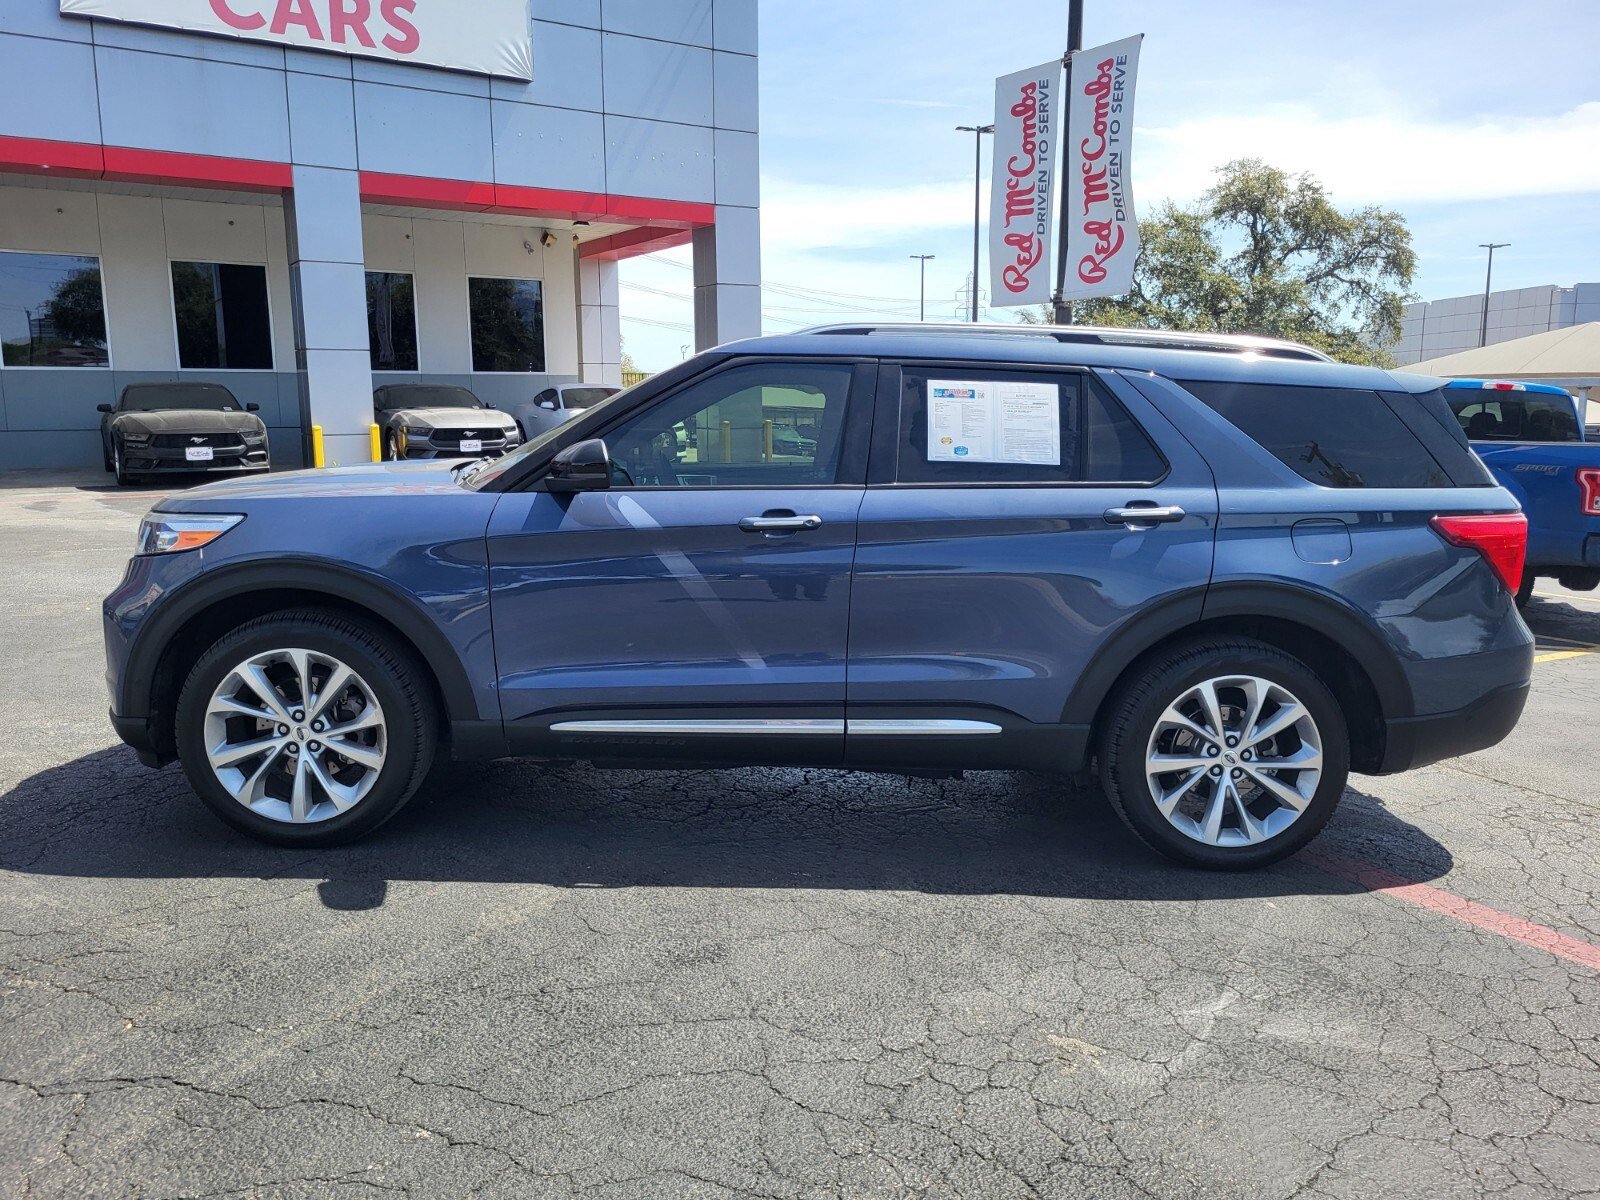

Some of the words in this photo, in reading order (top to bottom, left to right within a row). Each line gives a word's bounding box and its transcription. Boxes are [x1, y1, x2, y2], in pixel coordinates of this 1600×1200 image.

[1038, 78, 1050, 135] SERVE
[1111, 54, 1128, 114] SERVE
[1038, 139, 1049, 165] TO
[1109, 119, 1121, 147] TO
[1036, 169, 1049, 235] DRIVEN
[1109, 152, 1126, 222] DRIVEN
[1002, 231, 1043, 294] Red
[1078, 217, 1125, 285] Red
